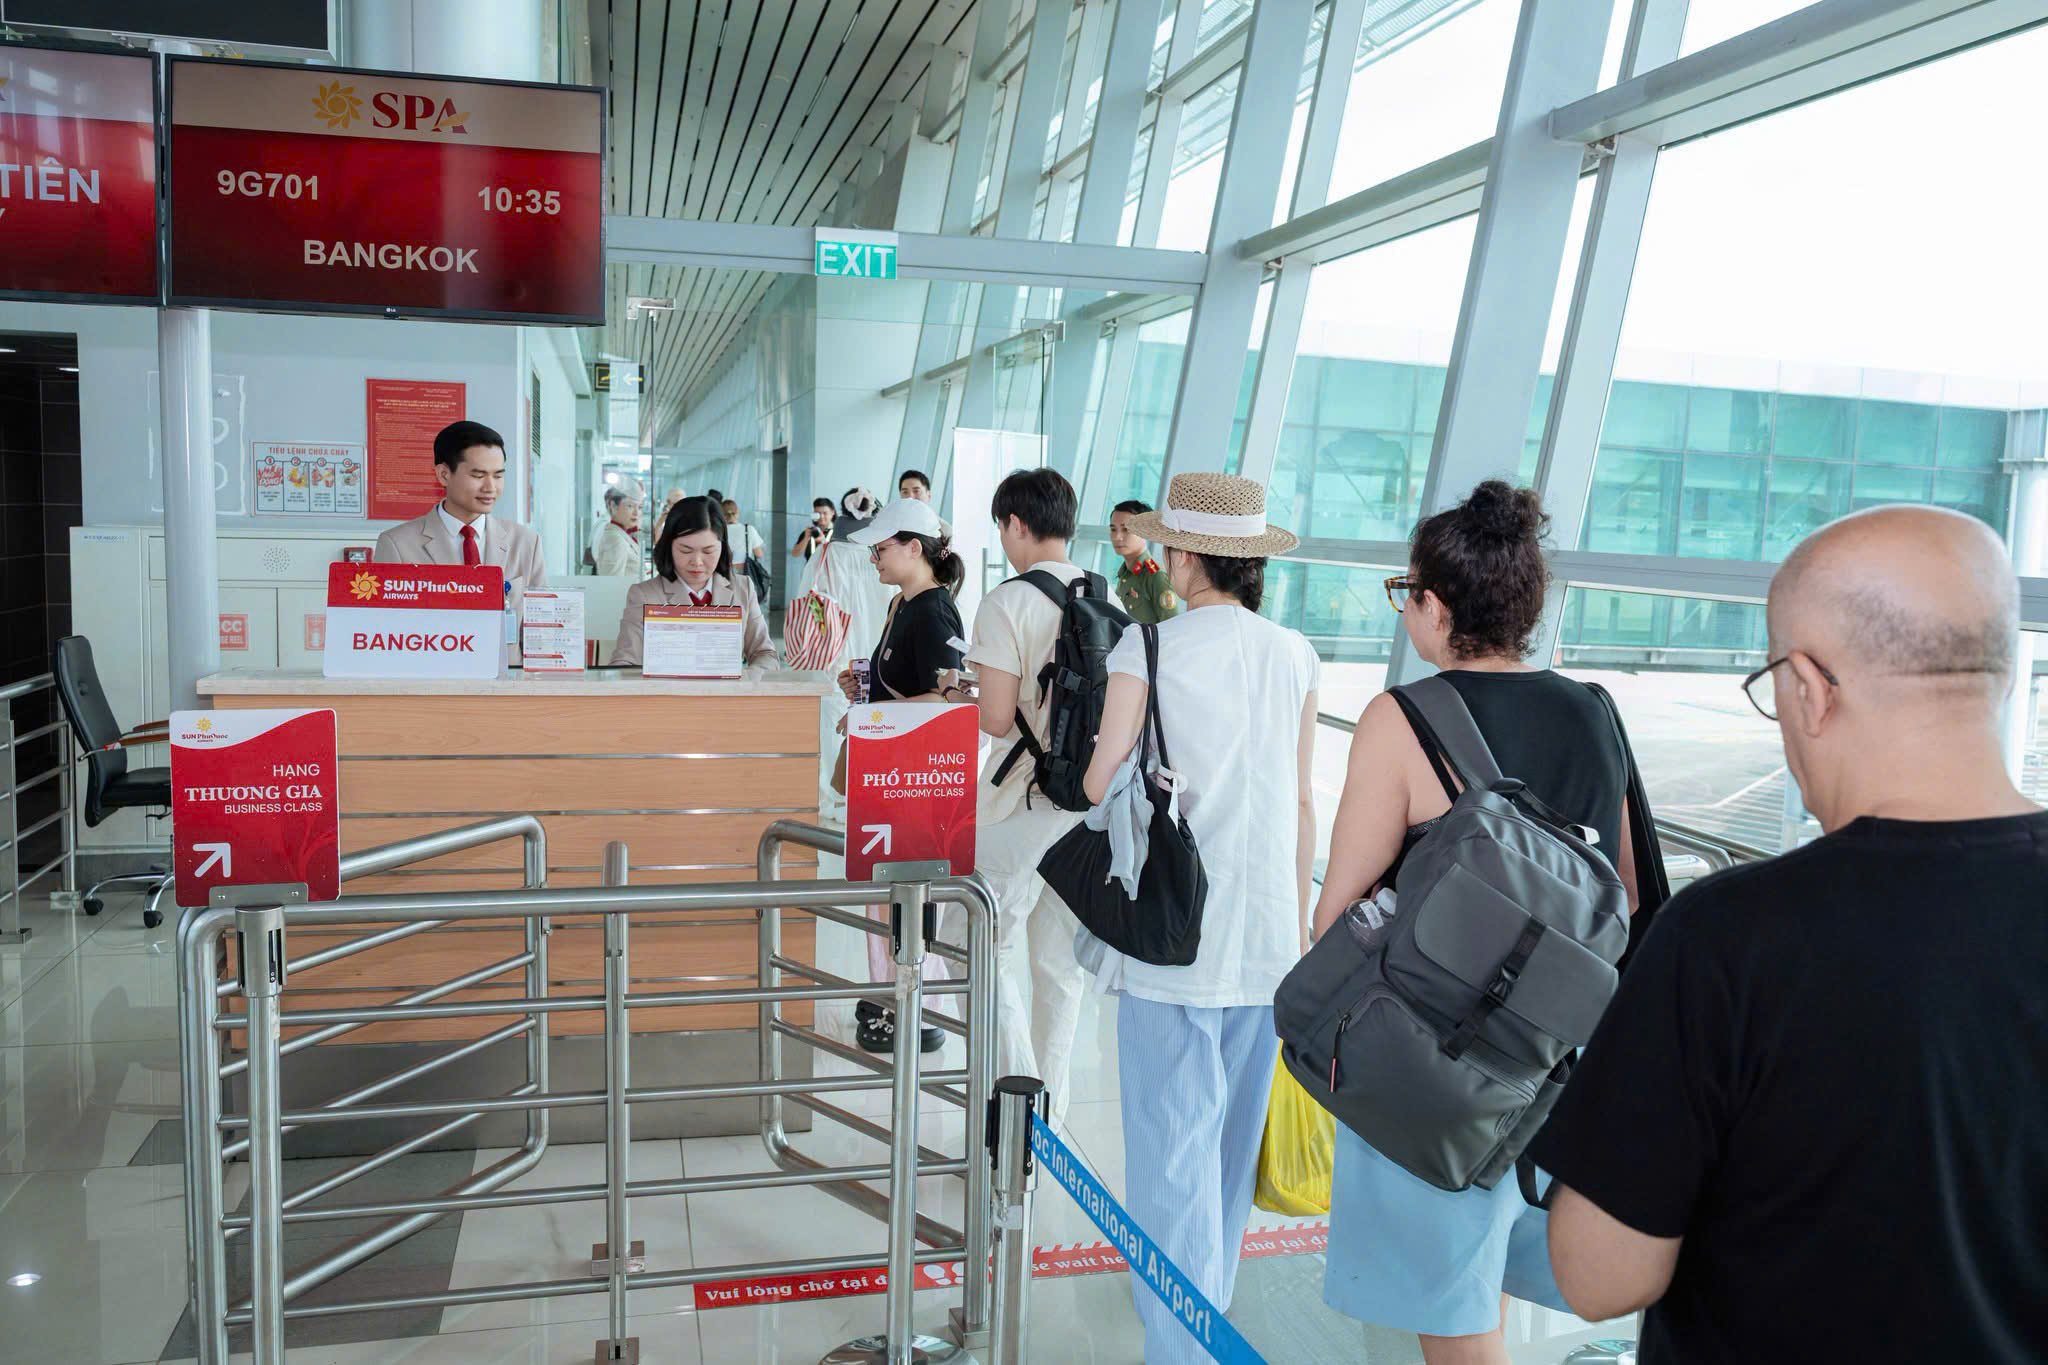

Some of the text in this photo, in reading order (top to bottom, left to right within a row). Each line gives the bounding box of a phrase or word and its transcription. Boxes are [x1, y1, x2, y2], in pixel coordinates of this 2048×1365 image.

[372, 91, 469, 134] SPA
[217, 169, 319, 201] 9G701
[477, 186, 561, 215] 10:35
[303, 239, 479, 274] BANGKOK
[820, 243, 894, 278] EXIT
[383, 580, 415, 592] SUN
[219, 620, 242, 632] CC
[353, 633, 475, 652] BANGKOK
[928, 753, 966, 767] HẠNG
[273, 764, 320, 780] HẠNG
[863, 768, 966, 786] PHỔ THÔNG
[286, 784, 323, 799] GIA
[883, 787, 965, 799] ECONOMY CLASS
[224, 802, 323, 814] BUSINESS CLASS
[1052, 1143, 1143, 1267] International
[1147, 1250, 1212, 1344] Airport
[1055, 1256, 1097, 1269] wait
[1103, 1254, 1125, 1266] he
[706, 1288, 739, 1301] Vui
[746, 1284, 792, 1297] lòng
[800, 1279, 835, 1292] chờ
[841, 1276, 868, 1290] tại
